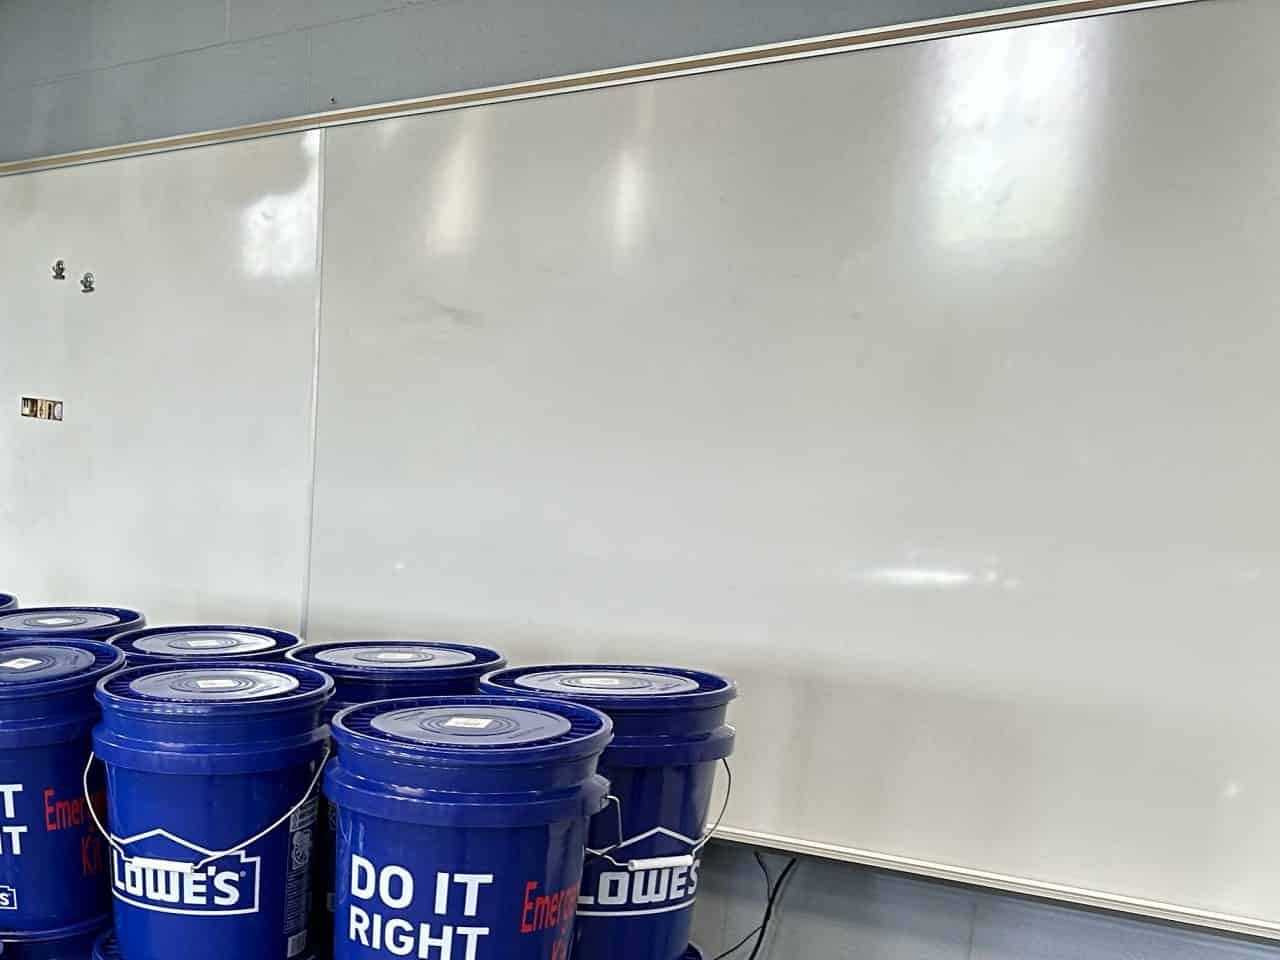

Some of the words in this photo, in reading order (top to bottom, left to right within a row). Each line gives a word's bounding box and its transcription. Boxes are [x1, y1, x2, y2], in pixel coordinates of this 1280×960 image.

[114, 849, 241, 907] LOWE'S
[351, 853, 414, 910] DO
[434, 872, 494, 917] IT
